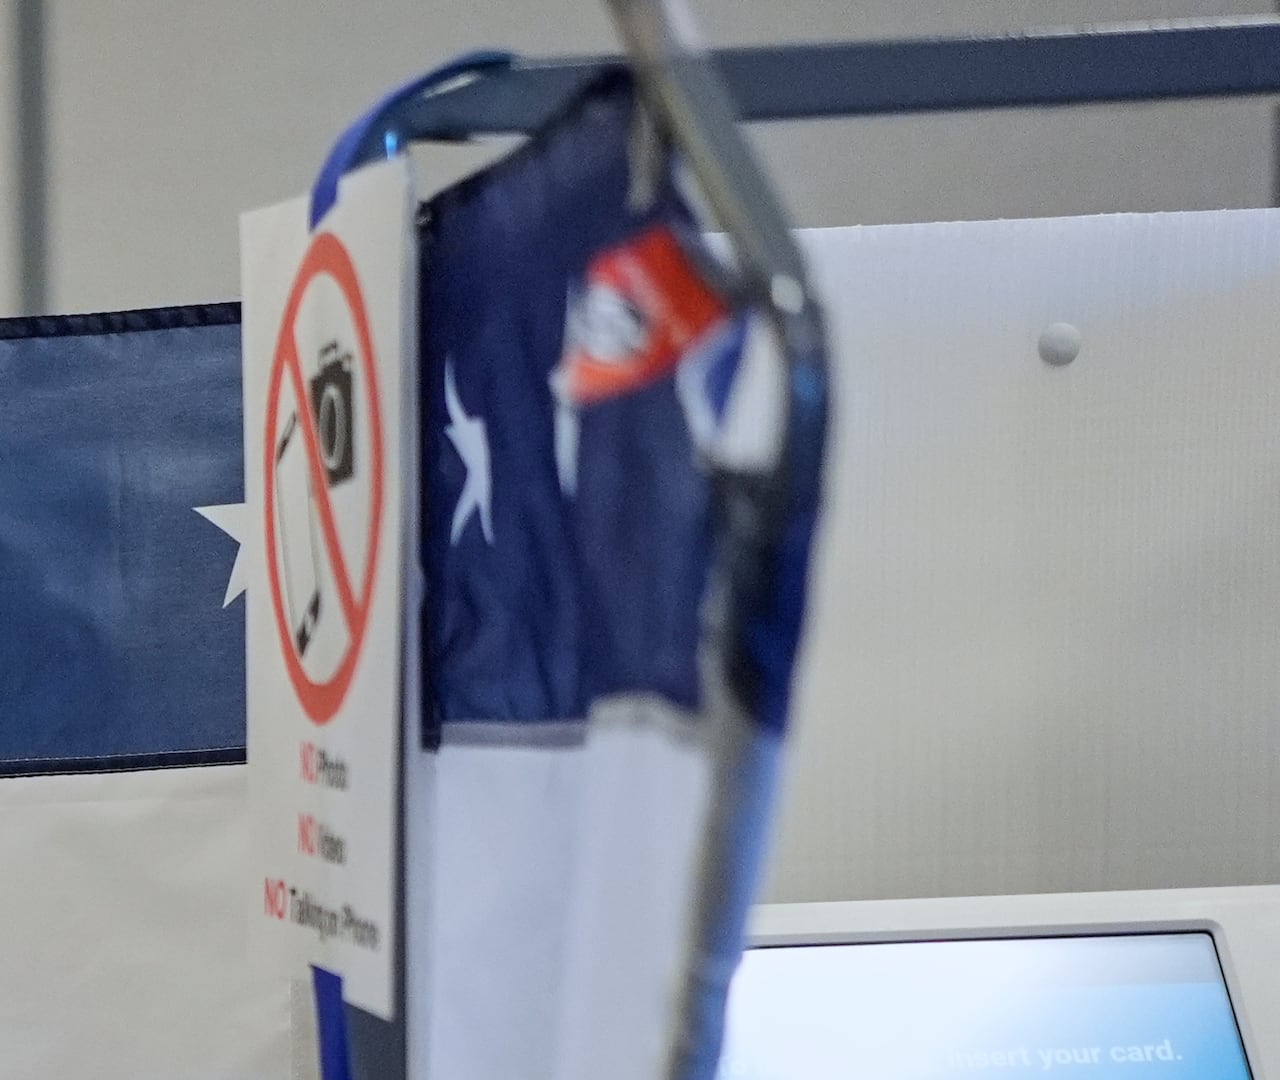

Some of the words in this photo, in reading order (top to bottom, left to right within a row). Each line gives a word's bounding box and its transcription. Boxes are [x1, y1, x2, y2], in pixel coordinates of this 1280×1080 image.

[299, 741, 317, 784] NO
[297, 813, 317, 856] NO
[264, 877, 287, 920] NO
[1039, 1046, 1100, 1071] your
[1110, 1038, 1183, 1063] card.
